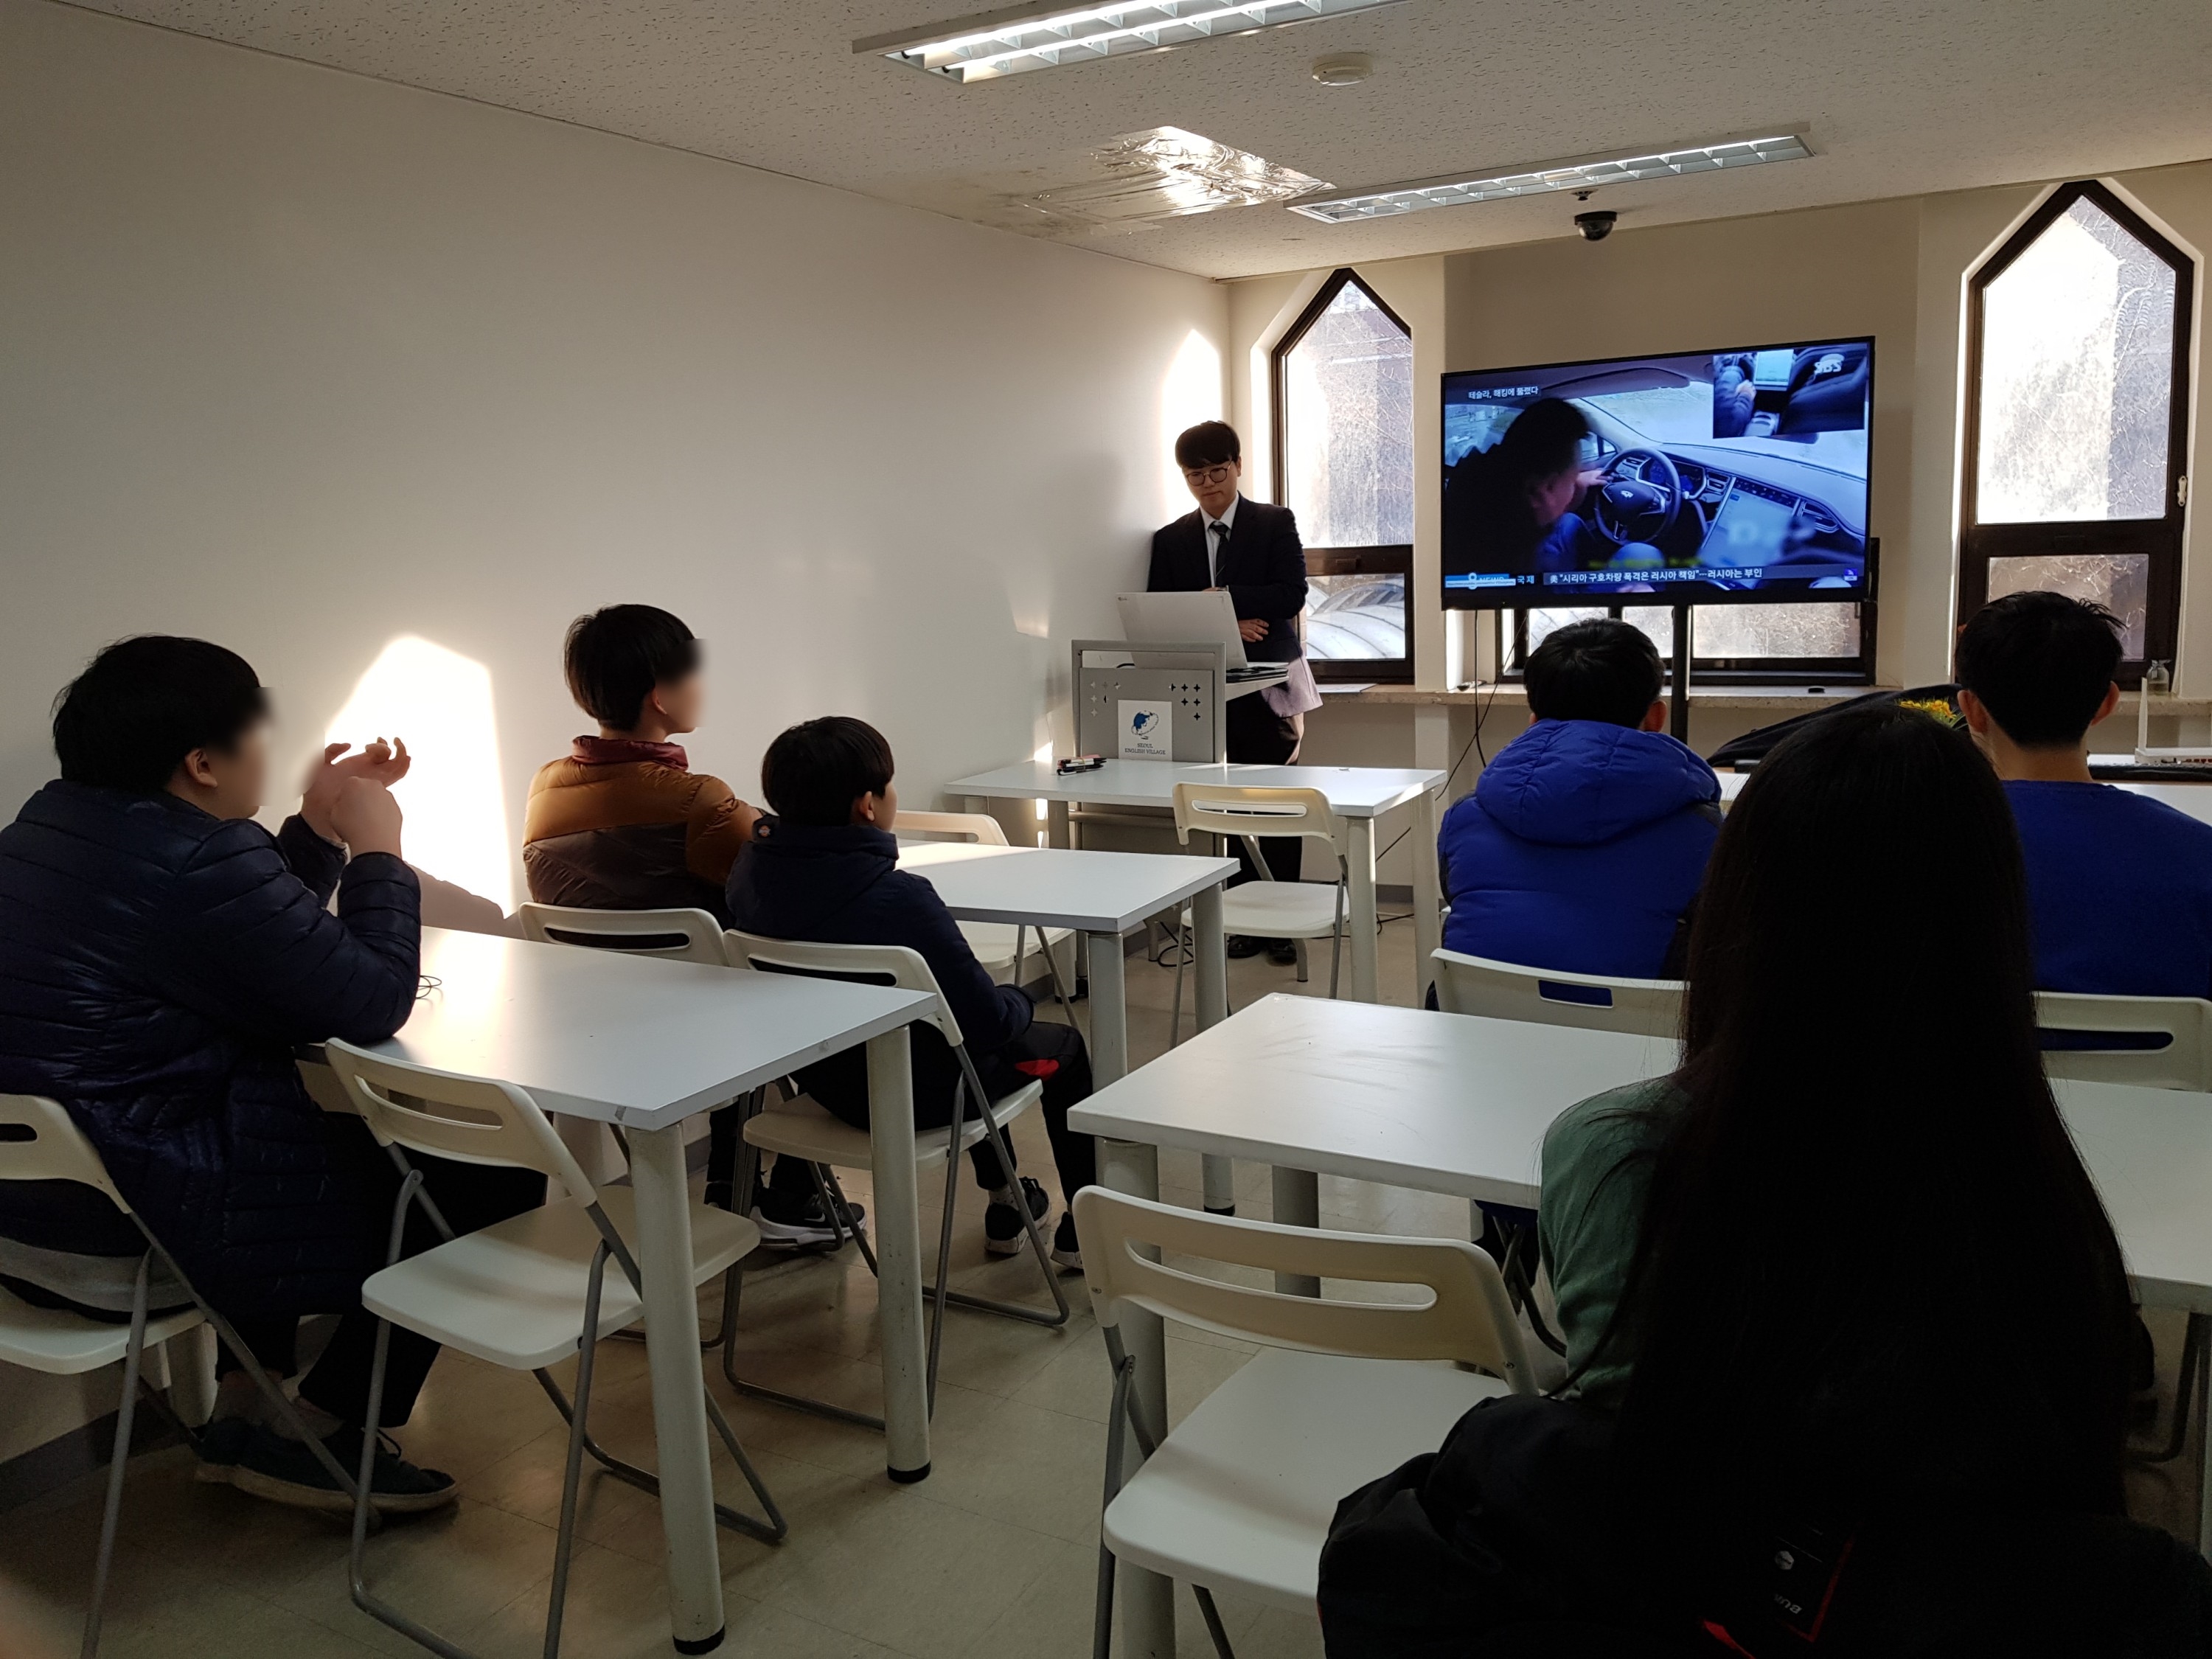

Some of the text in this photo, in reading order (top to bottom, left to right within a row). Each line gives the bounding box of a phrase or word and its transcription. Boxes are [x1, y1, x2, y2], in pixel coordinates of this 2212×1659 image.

[1493, 387, 1515, 397] 해킹에
[1516, 386, 1539, 396] 뚫렸다
[1588, 572, 1622, 582] 구호차량
[1624, 571, 1649, 582] 폭격은
[1651, 570, 1677, 581] 러시아
[1744, 568, 1762, 578] 부인
